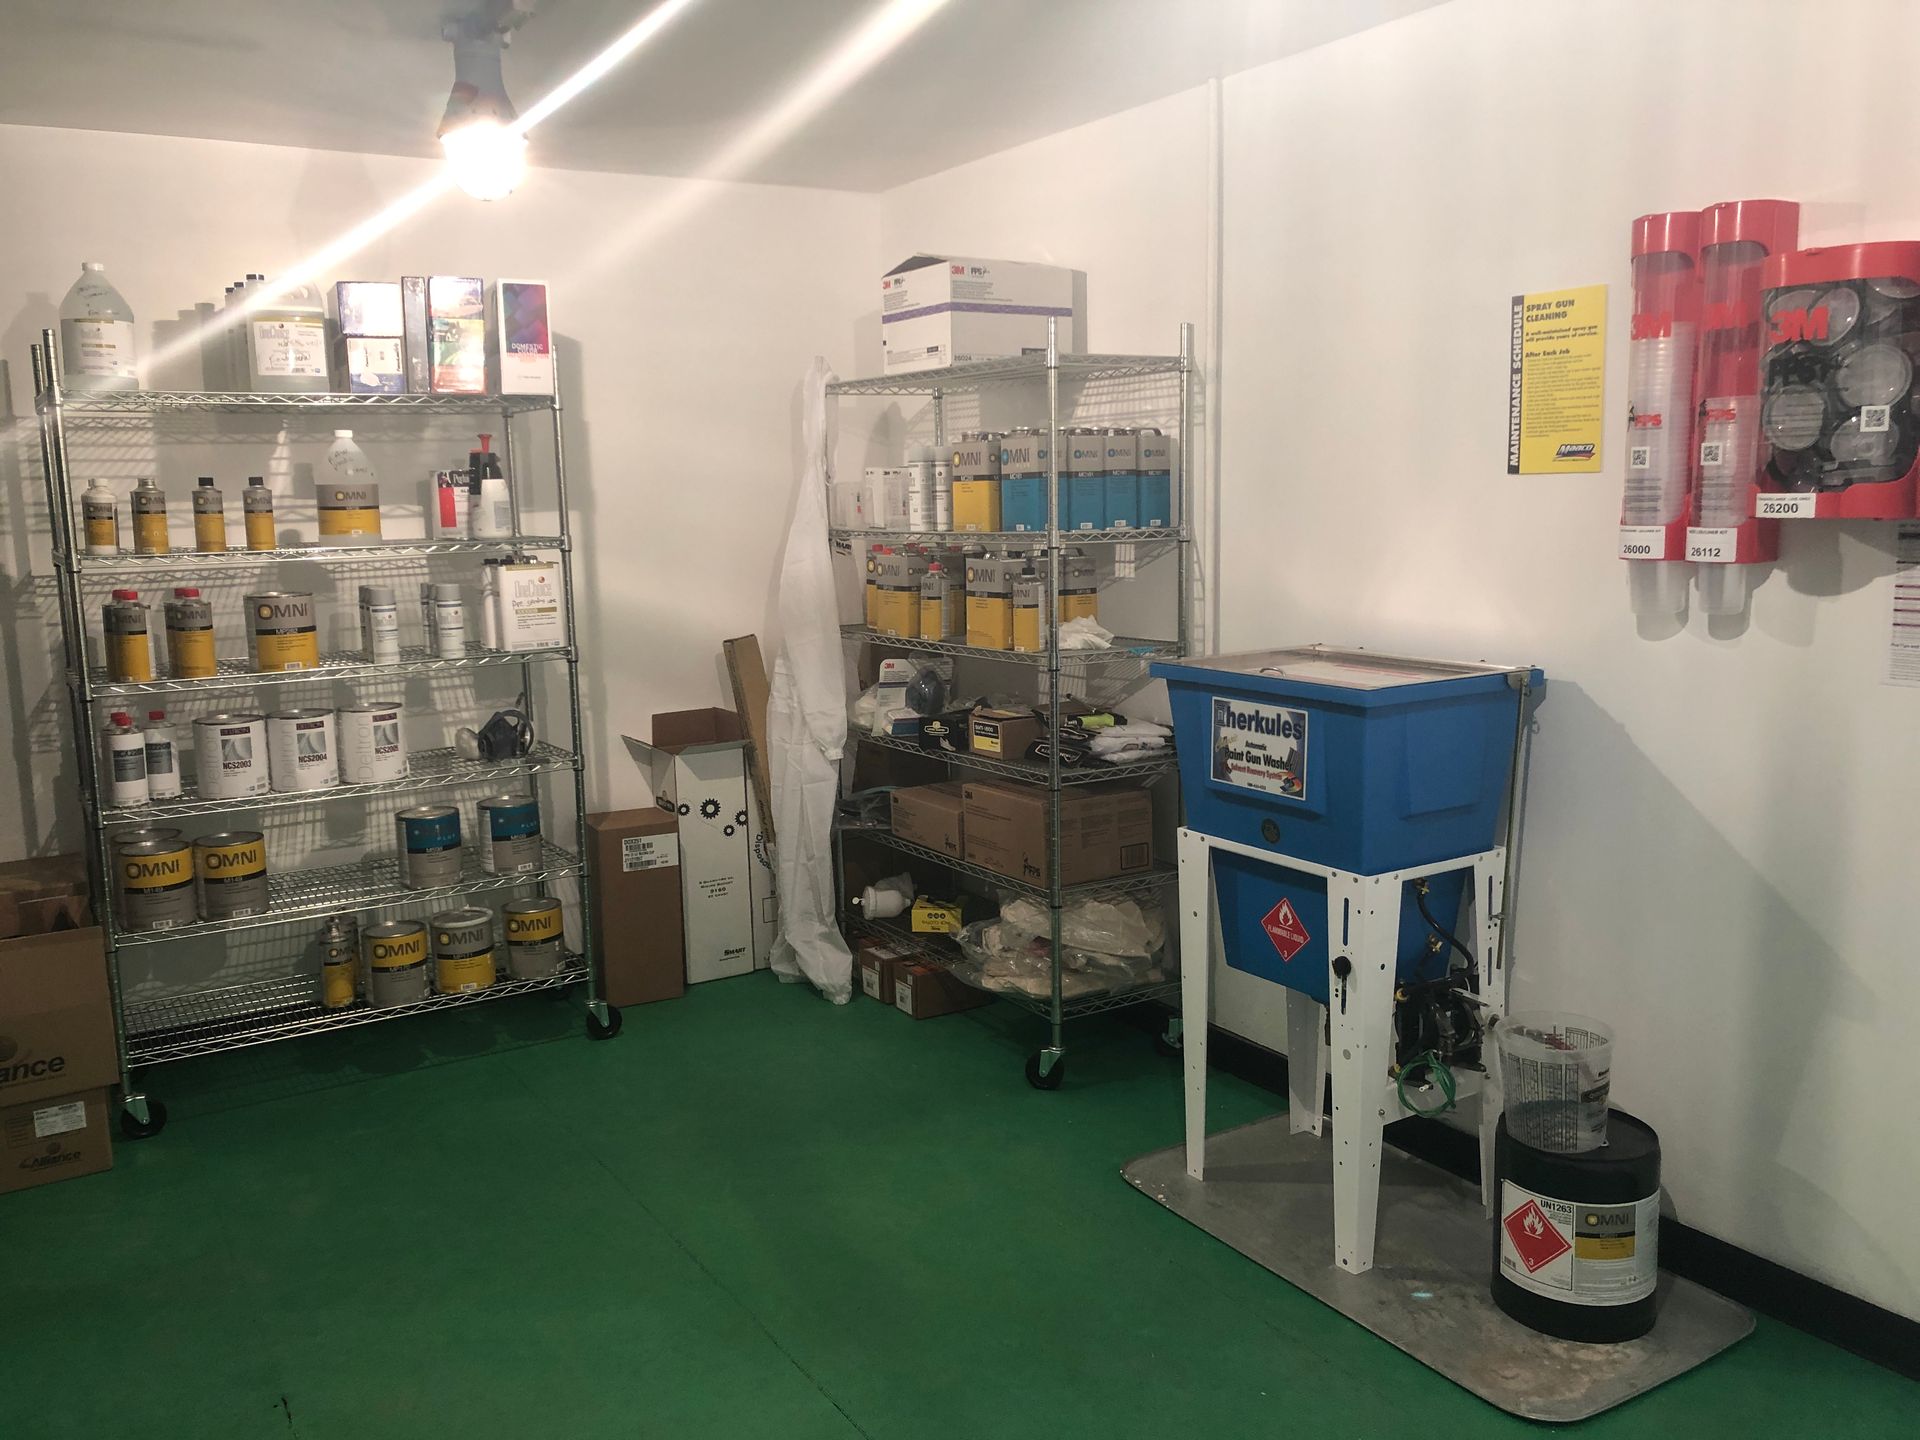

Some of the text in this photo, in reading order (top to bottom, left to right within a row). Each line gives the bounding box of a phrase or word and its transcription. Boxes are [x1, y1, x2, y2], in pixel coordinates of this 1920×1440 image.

[952, 265, 965, 275] 3M
[883, 281, 891, 289] 3M
[1526, 299, 1575, 312] SPRAY GUN
[1526, 311, 1567, 322] CLEANING
[1769, 305, 1830, 342] 3M
[1631, 312, 1672, 340] 3M
[1510, 304, 1523, 466] MAINTENANCE SCHEDULE
[953, 451, 981, 467] OMNI
[1001, 448, 1030, 465] OMNI
[335, 490, 367, 501] OMNI
[1763, 503, 1799, 513] 26200
[1623, 545, 1651, 554] 26000
[1691, 547, 1721, 557] 26112
[967, 567, 996, 583] OMNI
[257, 602, 309, 621] OMNI
[1226, 706, 1302, 740] herkules
[222, 760, 252, 770] NCS2003
[298, 753, 327, 764] NCS2004
[1225, 748, 1292, 771] Paint Gun Washer
[205, 849, 257, 870] OMNI
[126, 859, 180, 879] OMNI
[508, 916, 551, 932] OMNI
[440, 928, 484, 945] OMNI
[1267, 924, 1304, 944] FLAMMABLE LIQUID
[373, 939, 420, 959] OMNI
[1283, 949, 1288, 958] 3
[31, 1151, 81, 1168] Alliance
[1540, 1199, 1572, 1214] UN1263
[1585, 1213, 1629, 1227] OMNI
[1528, 1257, 1535, 1265] 3
